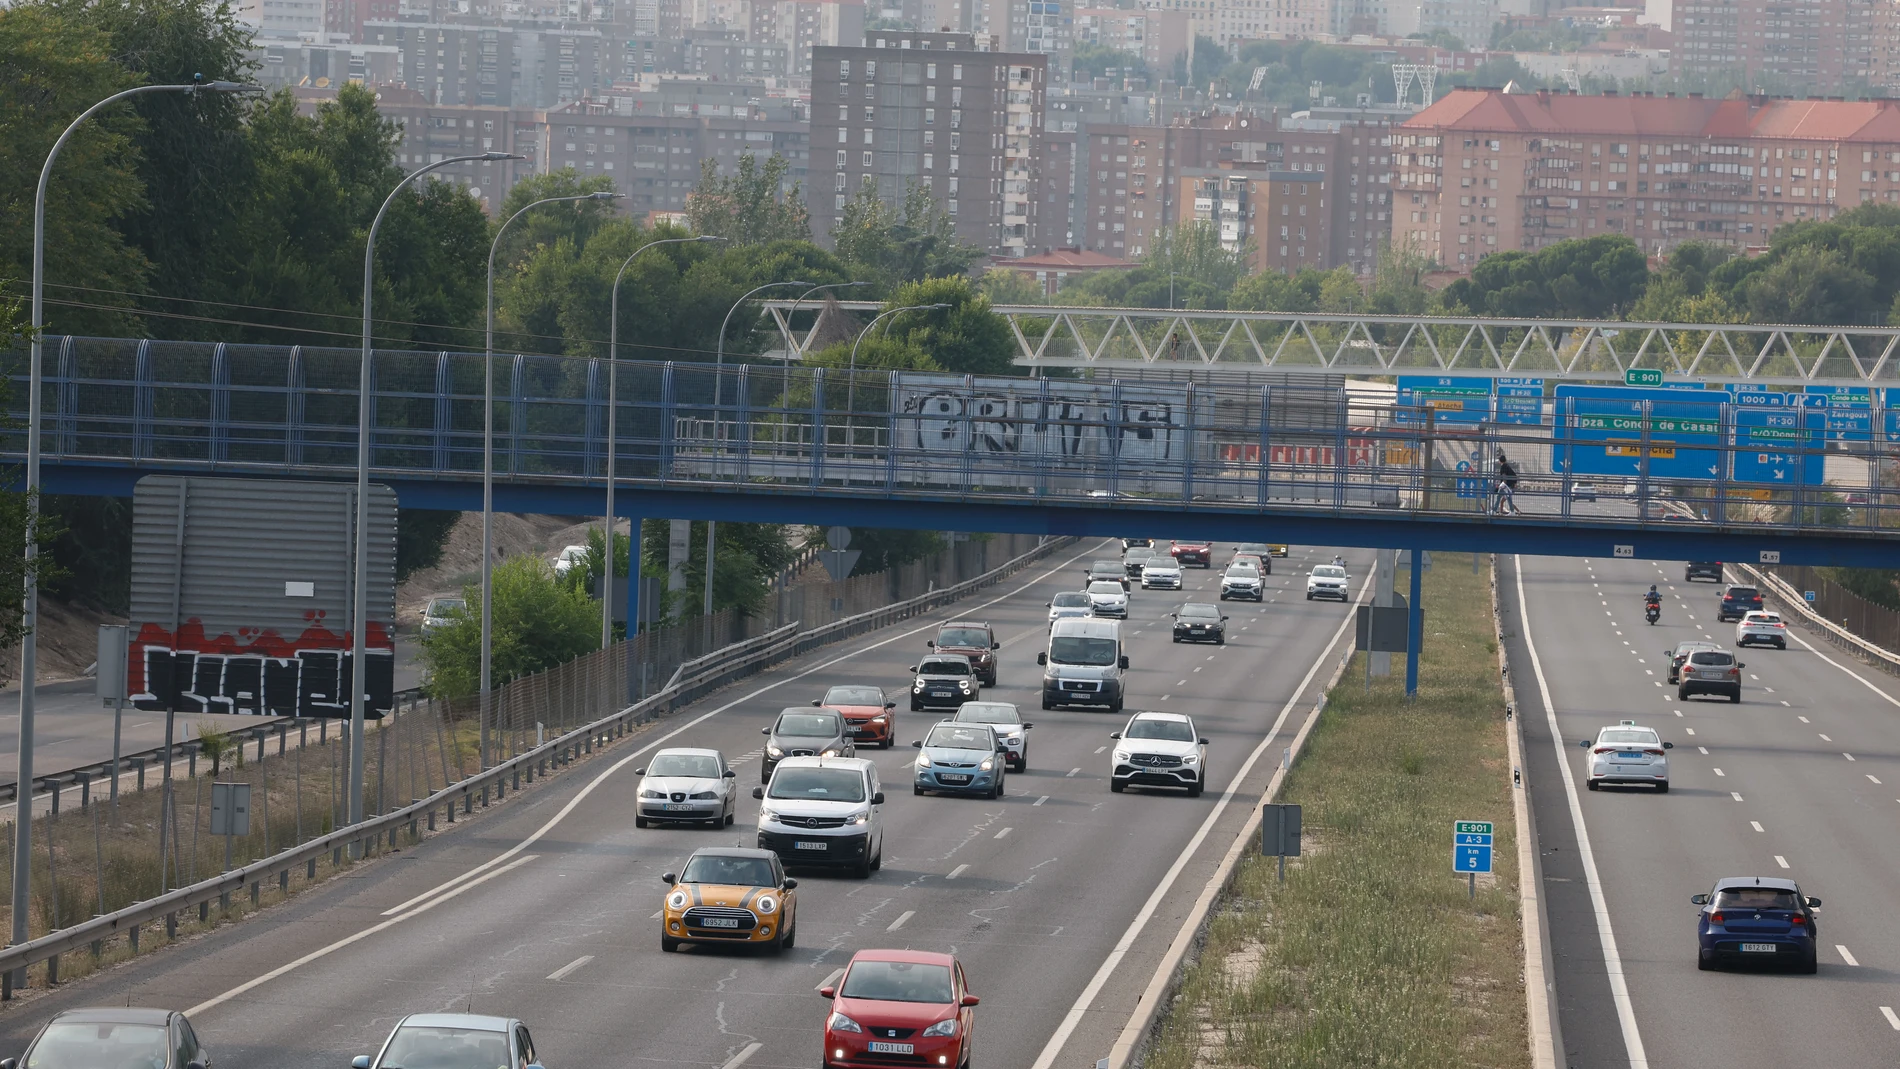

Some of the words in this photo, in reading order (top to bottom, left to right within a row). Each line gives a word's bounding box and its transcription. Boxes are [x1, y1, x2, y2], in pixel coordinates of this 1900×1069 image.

[1742, 396, 1766, 404] 1000
[1832, 410, 1868, 419] Zaragoza
[1659, 419, 1675, 430] de
[1768, 417, 1793, 425] M-30
[1461, 824, 1487, 832] E-901
[1465, 835, 1482, 844] A-3
[1468, 857, 1477, 868] 5
[875, 1043, 894, 1051] 1031
